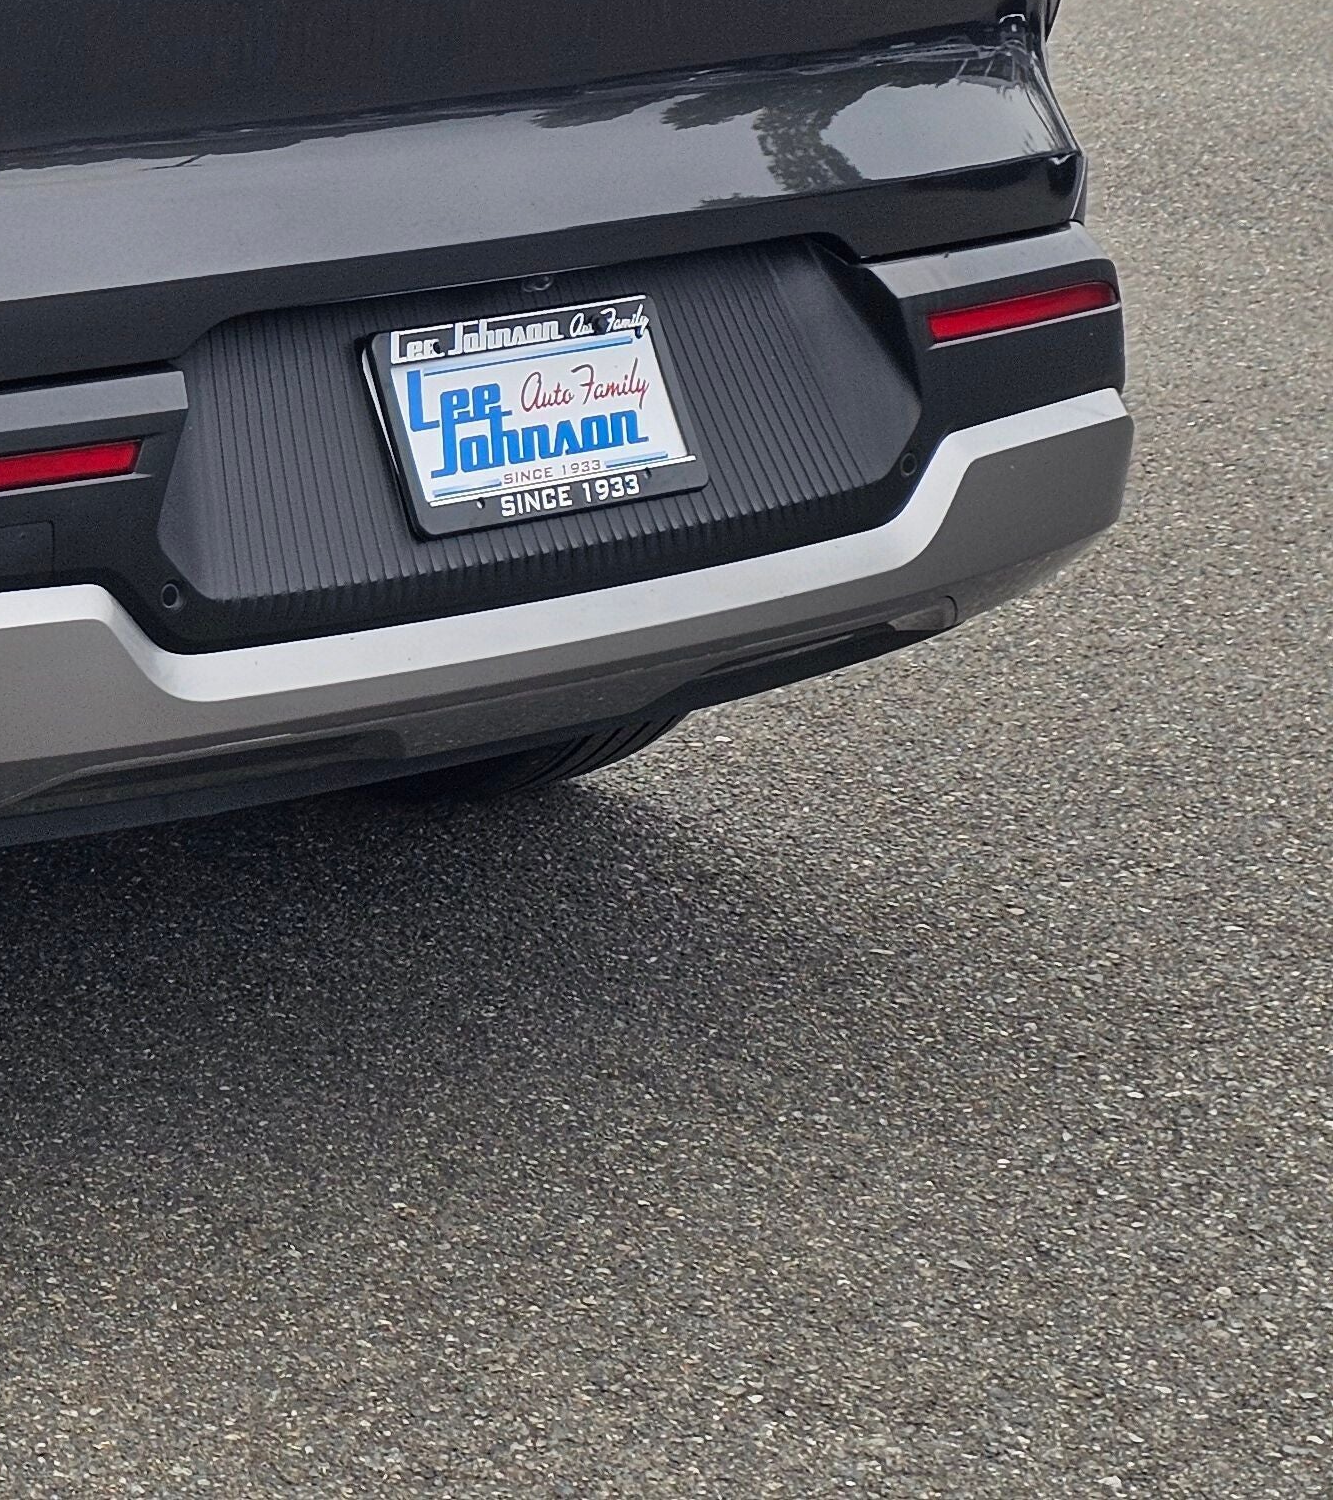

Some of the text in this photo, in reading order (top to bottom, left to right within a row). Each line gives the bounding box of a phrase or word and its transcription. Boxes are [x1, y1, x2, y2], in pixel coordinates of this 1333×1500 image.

[448, 318, 565, 355] Johnson
[406, 357, 650, 433] Lee Auto Family
[430, 405, 649, 479] Johnson
[503, 459, 602, 486] SINCE 1933
[501, 474, 641, 518] SINCE 1933
